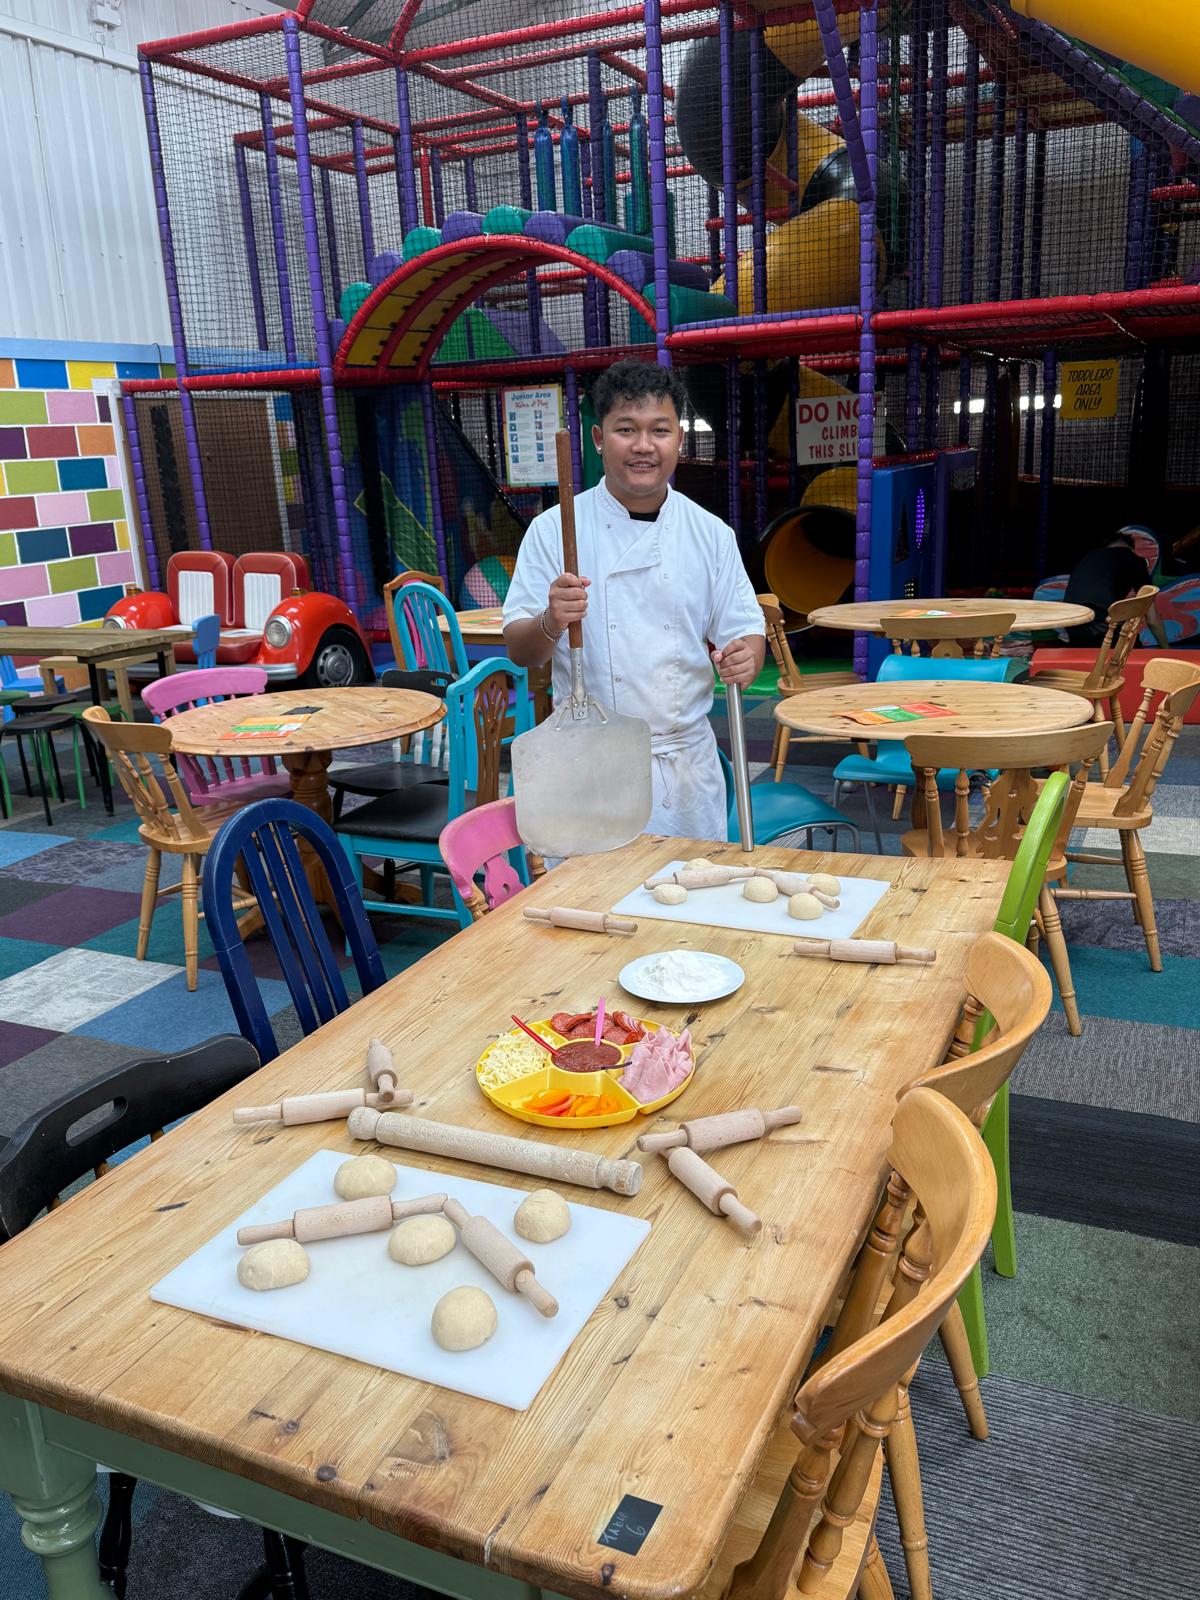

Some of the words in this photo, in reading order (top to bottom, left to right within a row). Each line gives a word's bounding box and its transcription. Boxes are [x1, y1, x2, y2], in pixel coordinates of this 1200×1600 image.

[1067, 368, 1114, 382] TODDLERS
[511, 392, 533, 401] Junior
[535, 391, 551, 399] Area
[1075, 383, 1101, 396] AREA
[1073, 397, 1102, 411] ONLY
[799, 402, 829, 424] DO
[822, 425, 857, 440] CLIMB
[809, 444, 834, 459] THIS
[839, 442, 856, 456] SLI
[625, 1524, 646, 1536] 6
